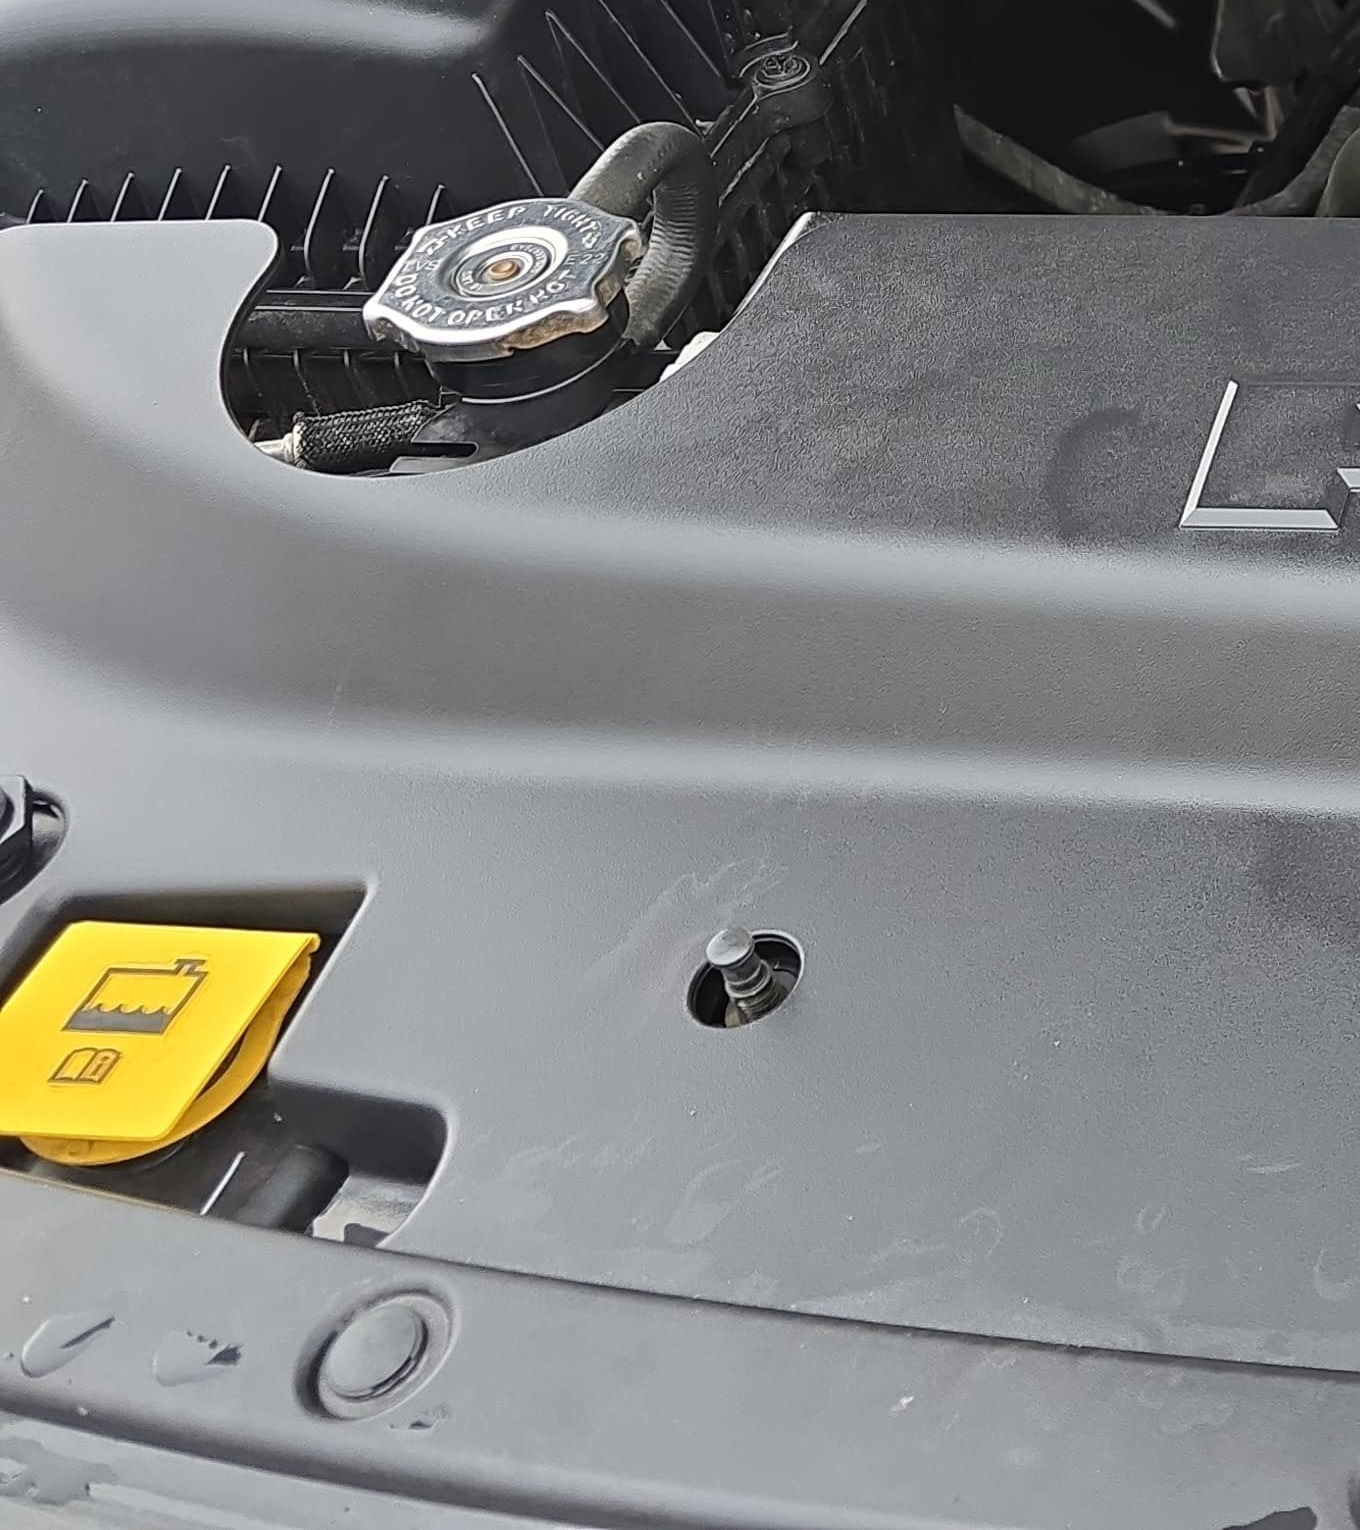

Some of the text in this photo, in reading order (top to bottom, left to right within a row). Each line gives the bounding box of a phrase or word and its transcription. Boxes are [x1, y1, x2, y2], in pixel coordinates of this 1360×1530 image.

[446, 206, 526, 238] KEEP
[394, 272, 416, 298] DO
[402, 298, 444, 322] NOT
[447, 300, 524, 326] OPEN
